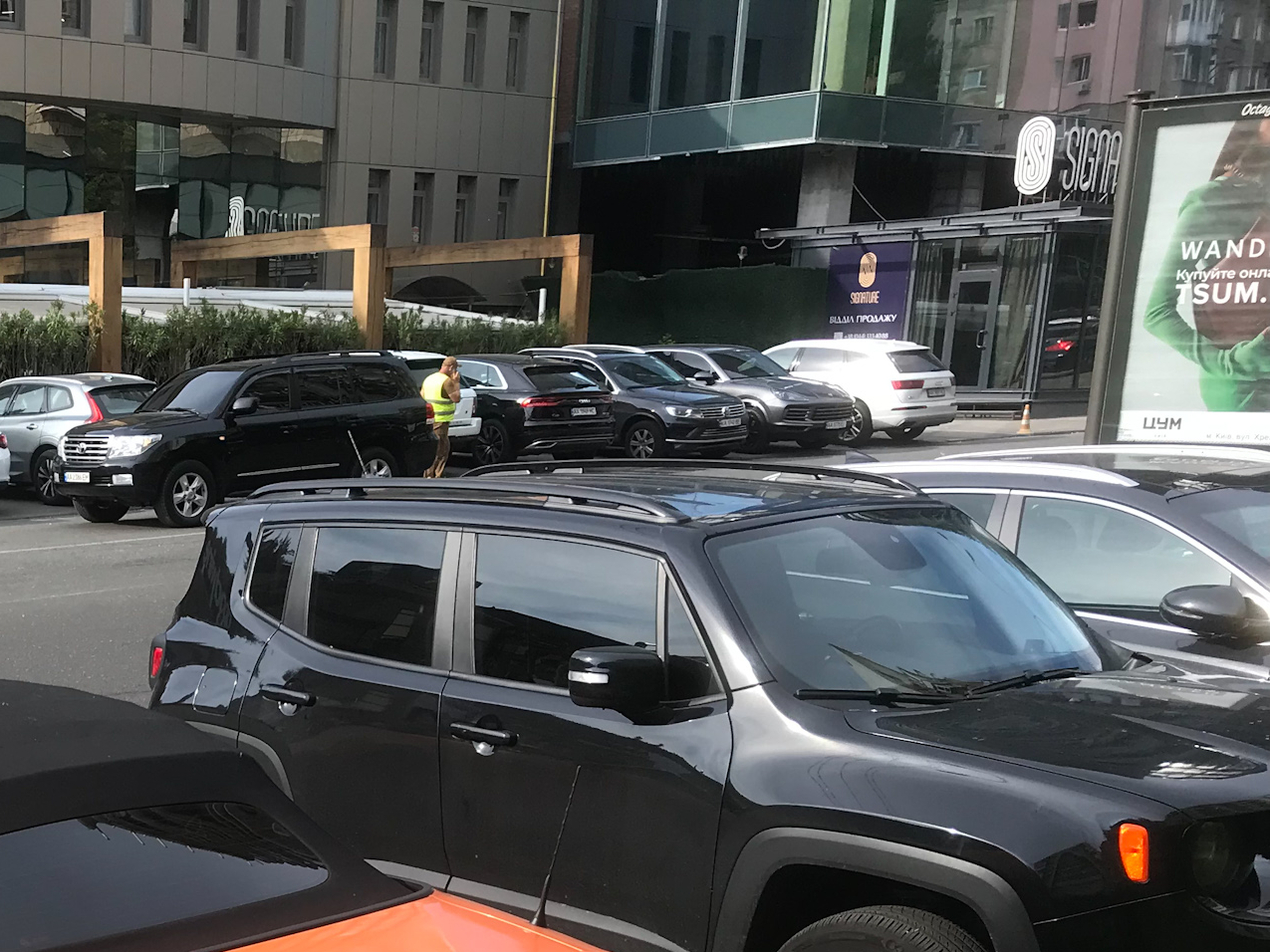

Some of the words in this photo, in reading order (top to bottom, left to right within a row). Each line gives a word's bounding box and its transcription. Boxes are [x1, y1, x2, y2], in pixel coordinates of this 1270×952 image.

[1176, 267, 1236, 282] Купуйте
[856, 314, 898, 323] ПРОДАЖУ
[1143, 417, 1182, 430] ЦУМ
